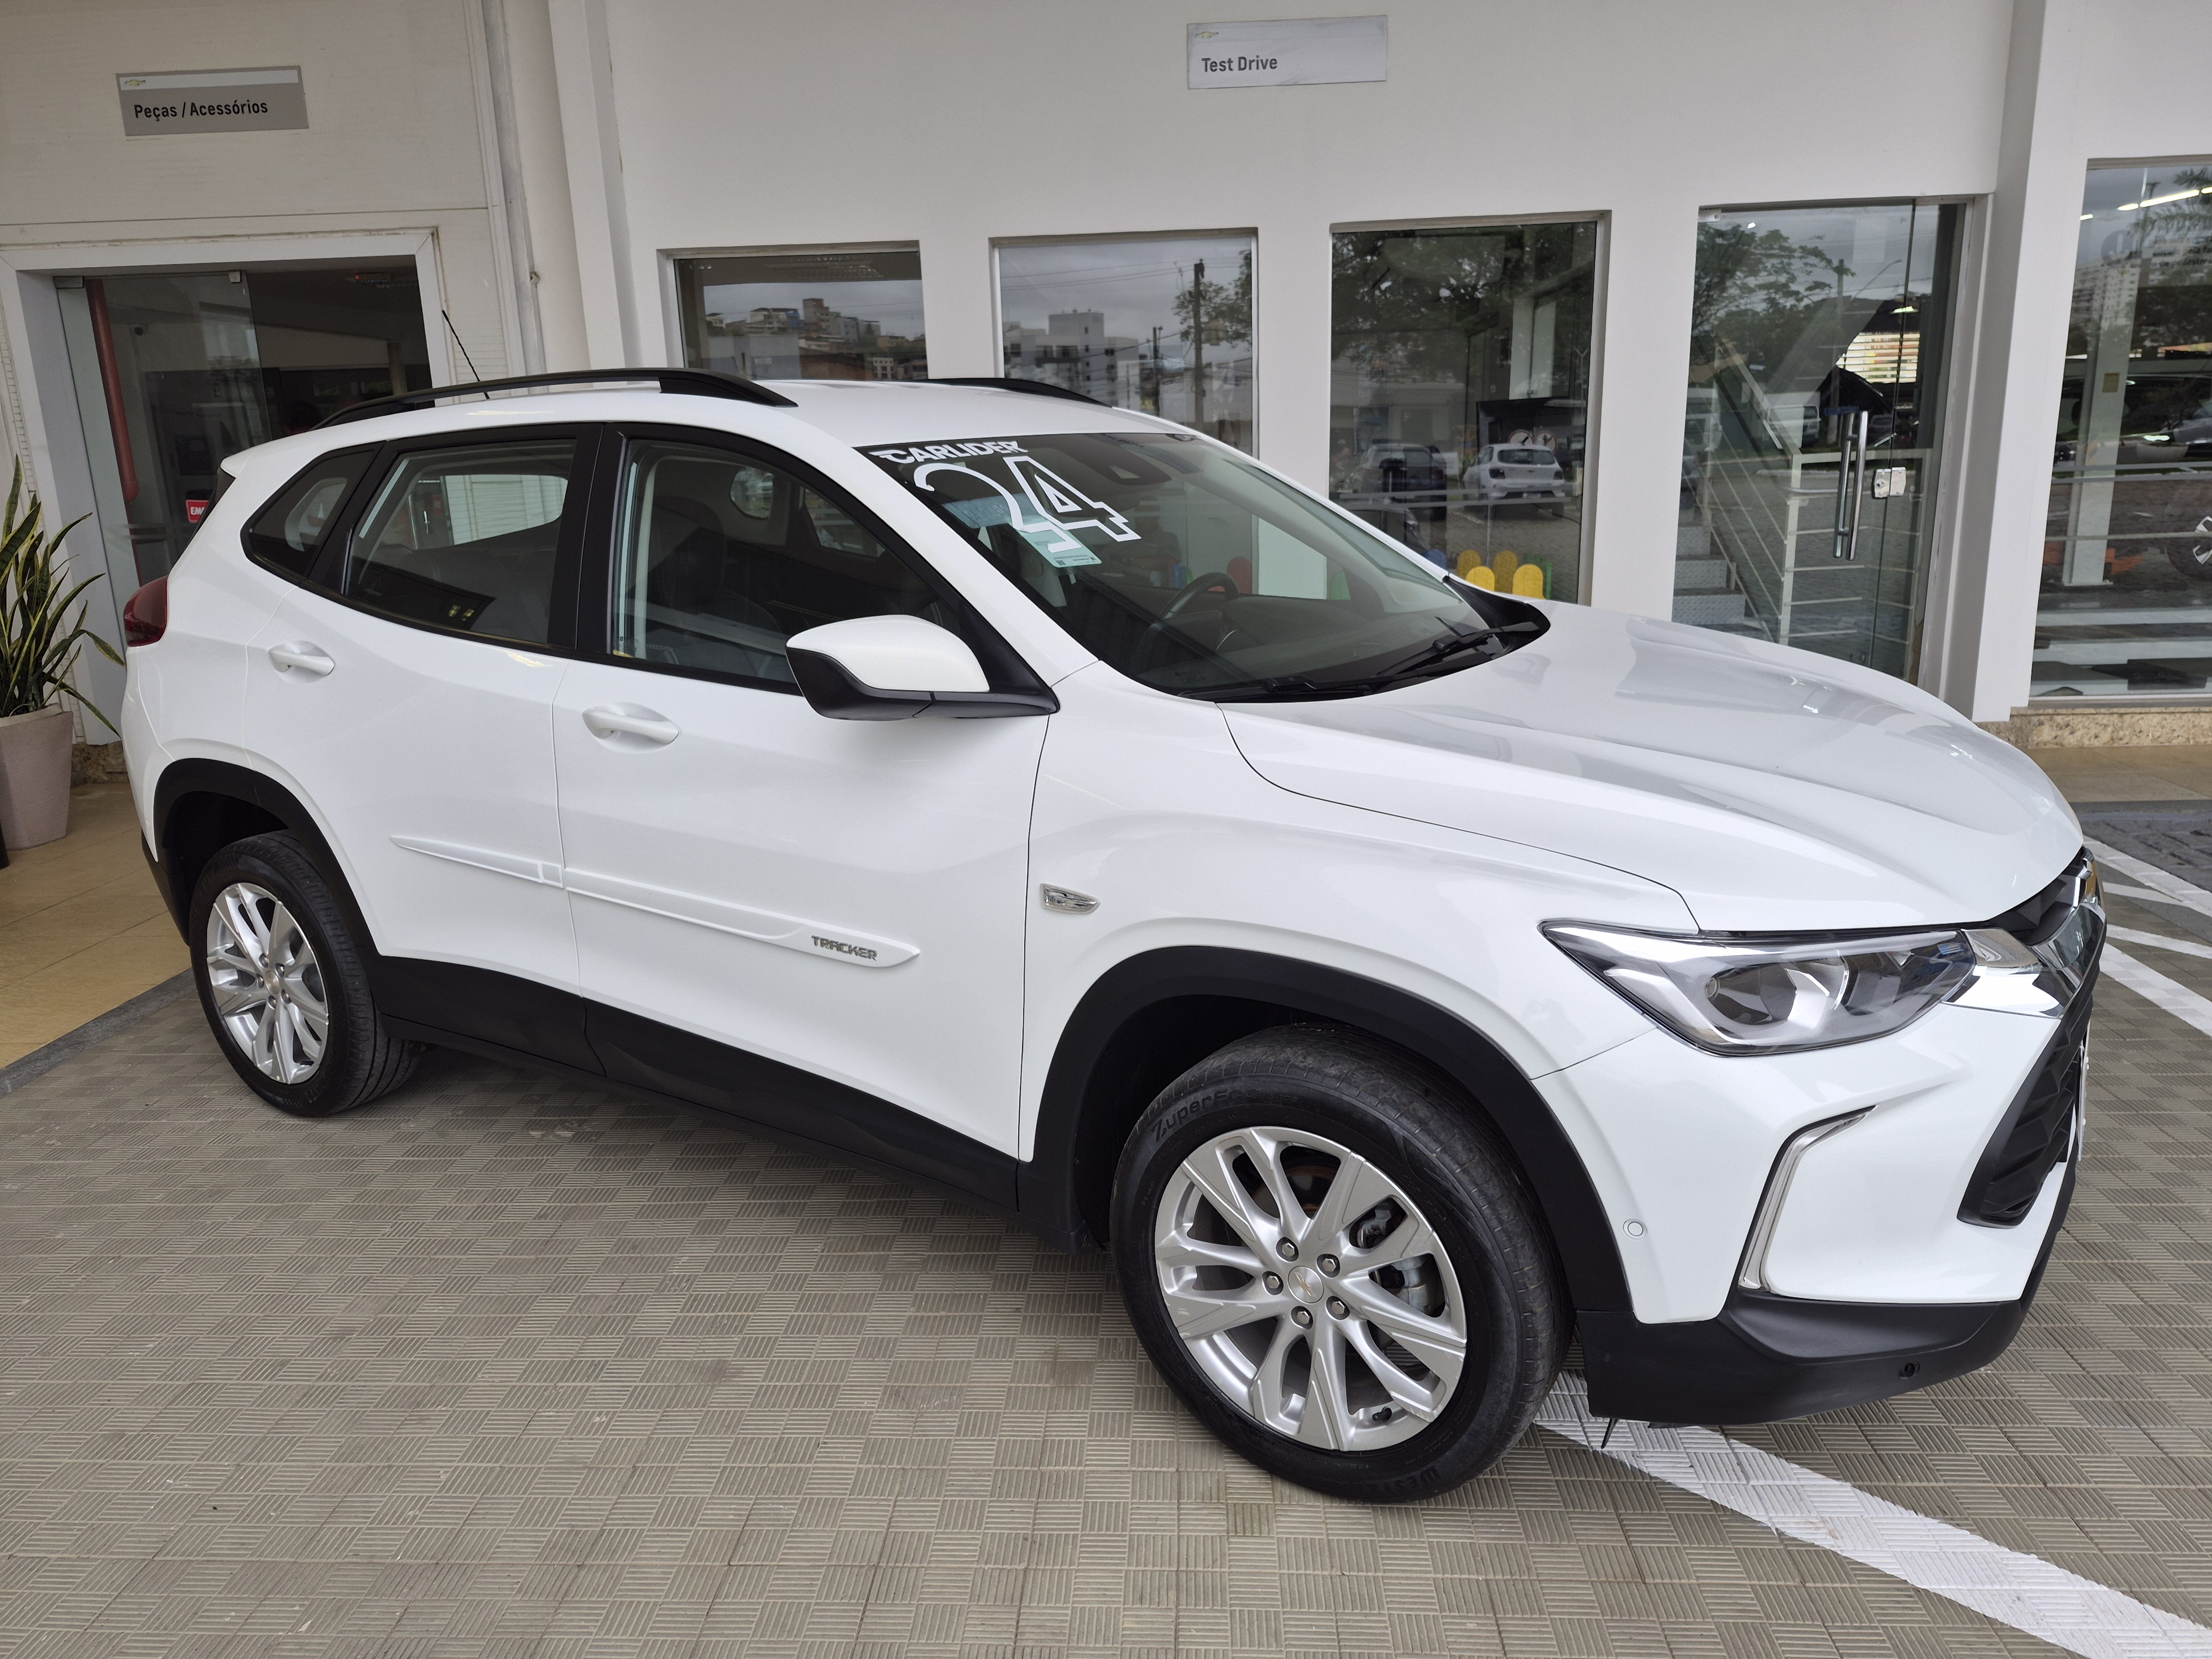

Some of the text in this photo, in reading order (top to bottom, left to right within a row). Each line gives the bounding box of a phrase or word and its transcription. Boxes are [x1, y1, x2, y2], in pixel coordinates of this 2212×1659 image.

[1201, 55, 1277, 72] Test Drive
[134, 100, 268, 122] Peças / Acessórios
[914, 456, 1141, 552] 24
[811, 935, 878, 961] TRACKER
